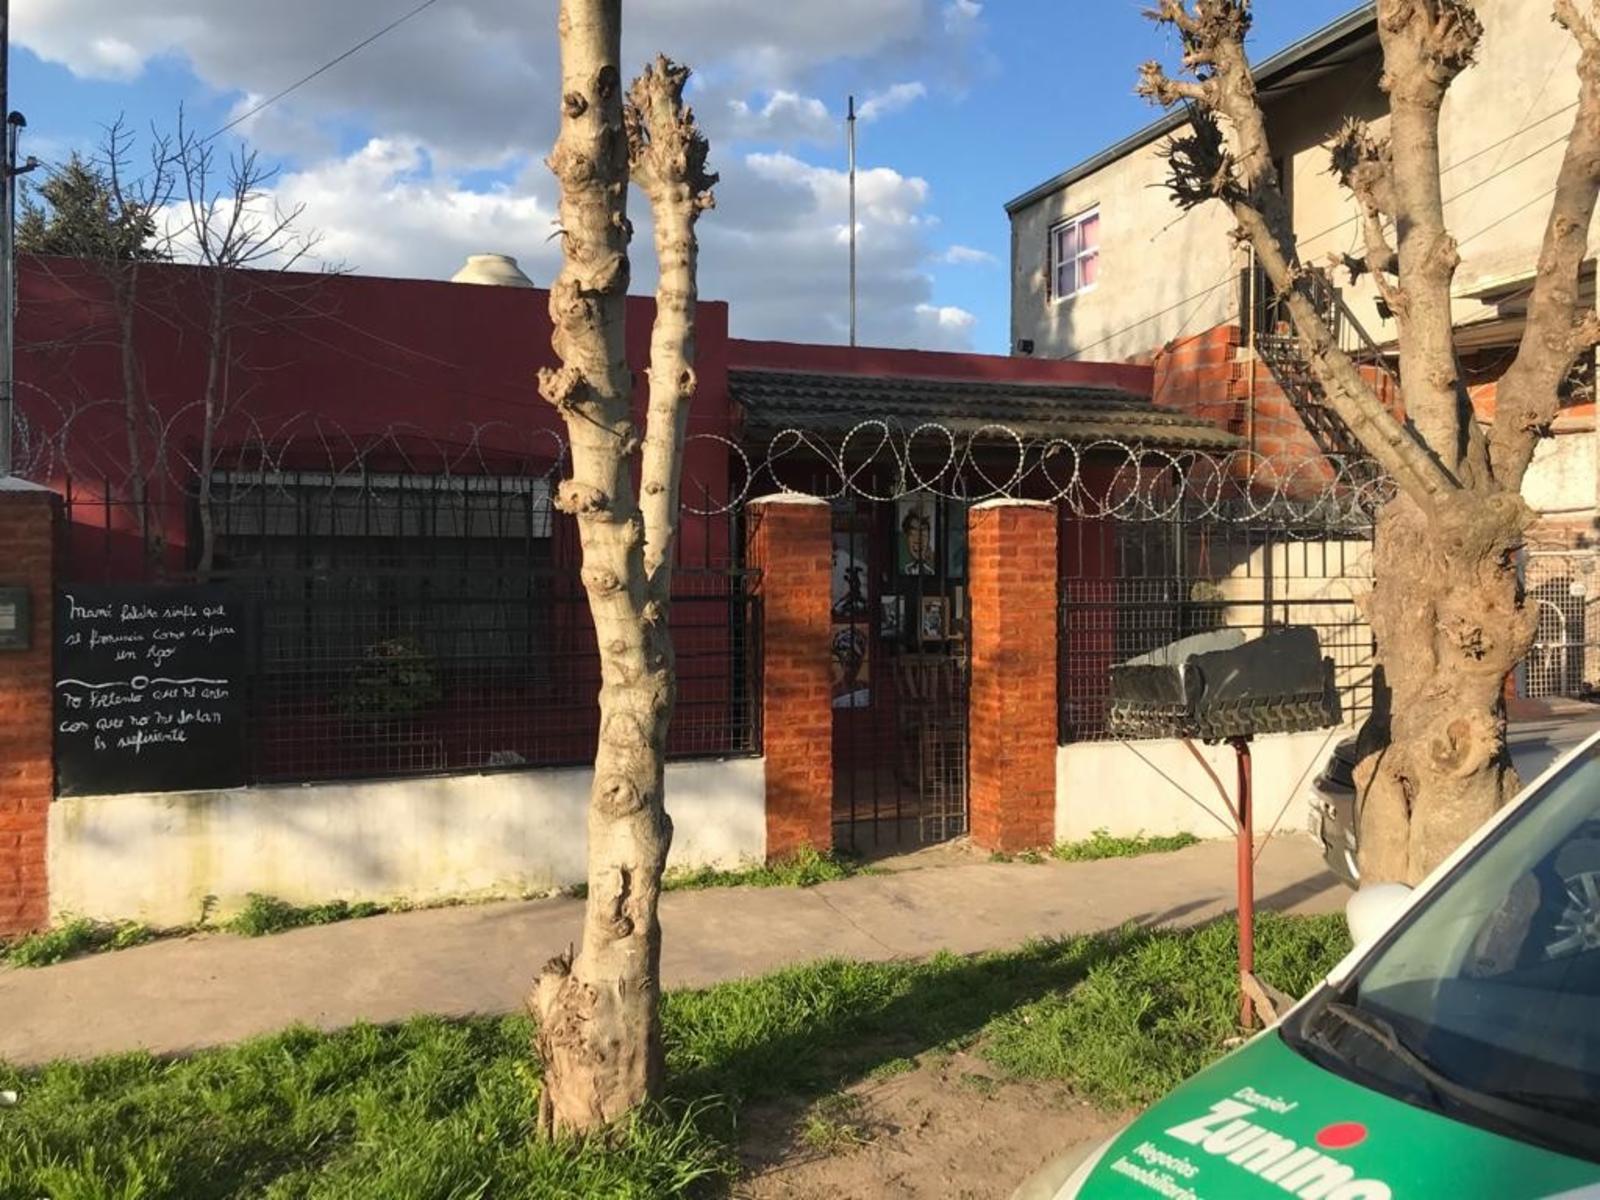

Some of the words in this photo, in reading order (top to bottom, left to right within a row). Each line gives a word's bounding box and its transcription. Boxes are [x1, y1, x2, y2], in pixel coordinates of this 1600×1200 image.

[114, 650, 137, 661] un
[59, 720, 89, 733] con
[130, 715, 151, 726] no
[1233, 1086, 1299, 1114] Daniel
[1132, 1141, 1200, 1178] Negocios
[1164, 1098, 1392, 1200] Zunino
